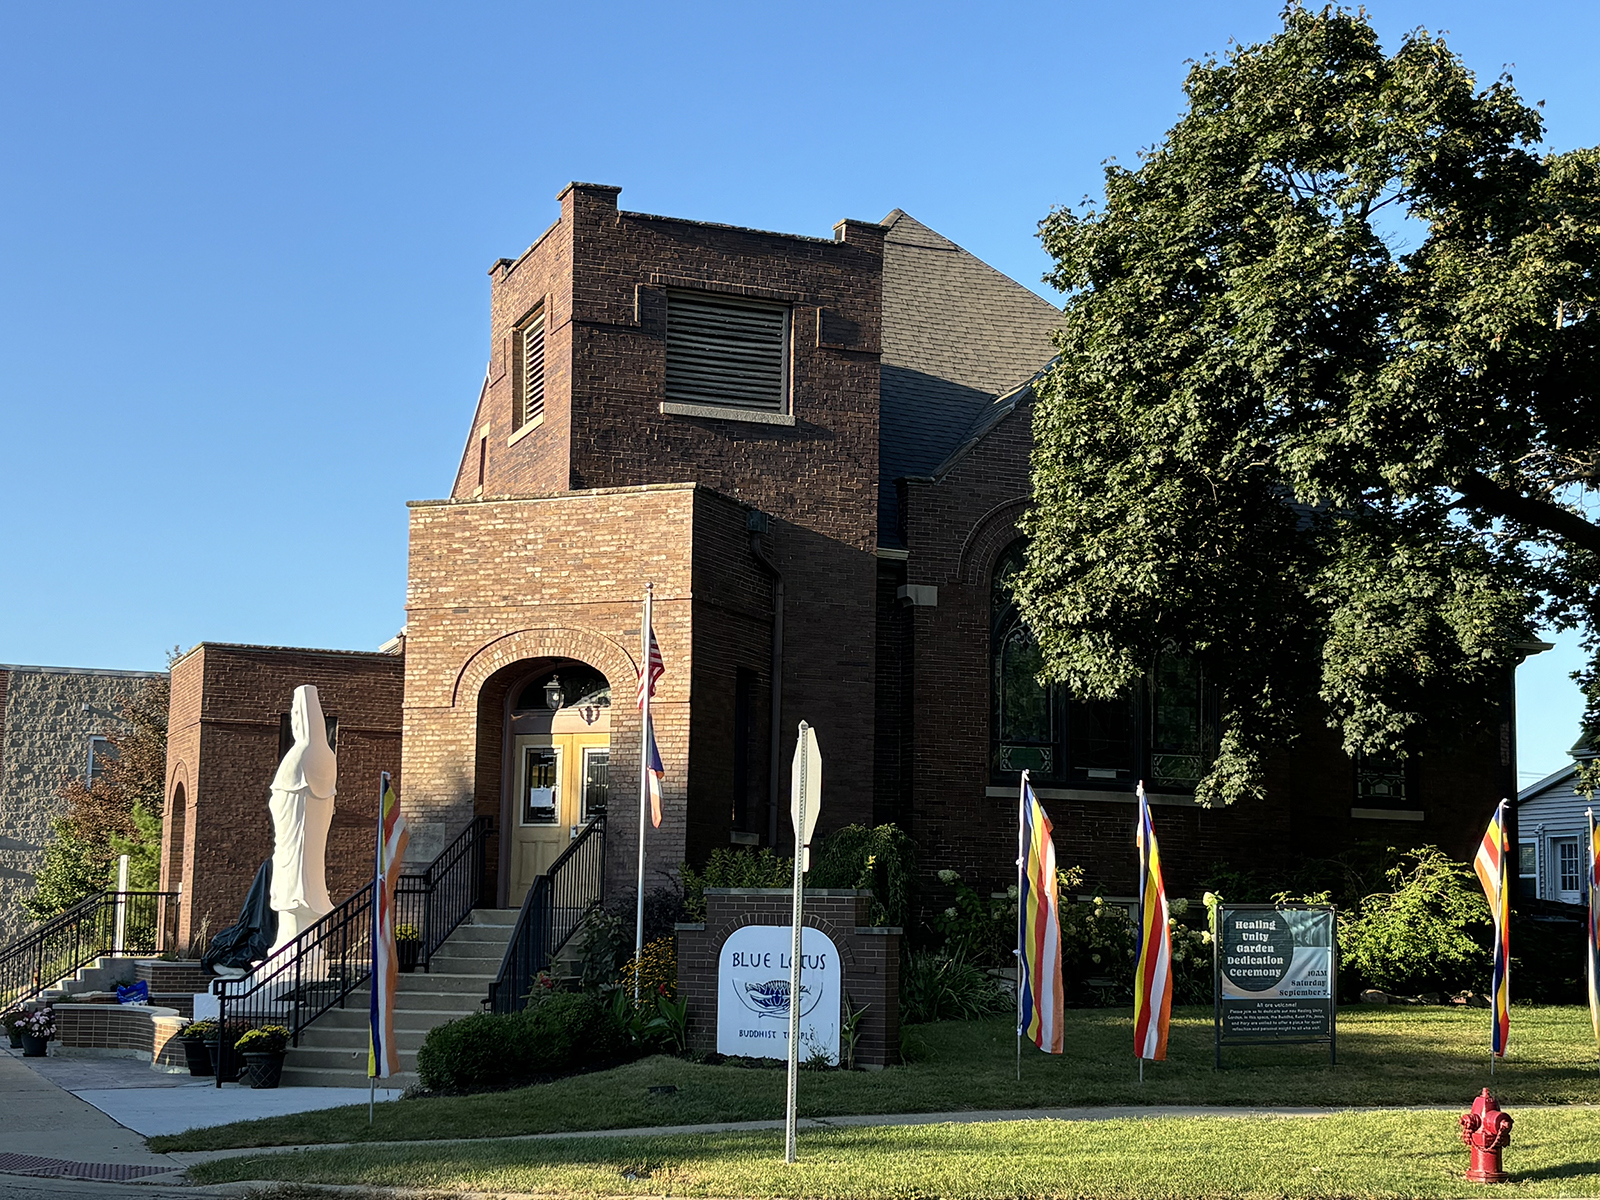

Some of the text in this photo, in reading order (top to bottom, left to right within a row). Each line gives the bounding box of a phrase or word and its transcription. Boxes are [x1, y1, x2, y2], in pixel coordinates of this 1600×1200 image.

[1235, 920, 1276, 930] Healing
[1242, 932, 1269, 942] Unity
[1236, 944, 1274, 953] Garden
[732, 952, 826, 970] BLUE LTUS
[1227, 956, 1284, 965] Dedication
[1229, 968, 1281, 978] Ceremony
[1279, 989, 1321, 997] September
[739, 1029, 777, 1038] BUDDHIST
